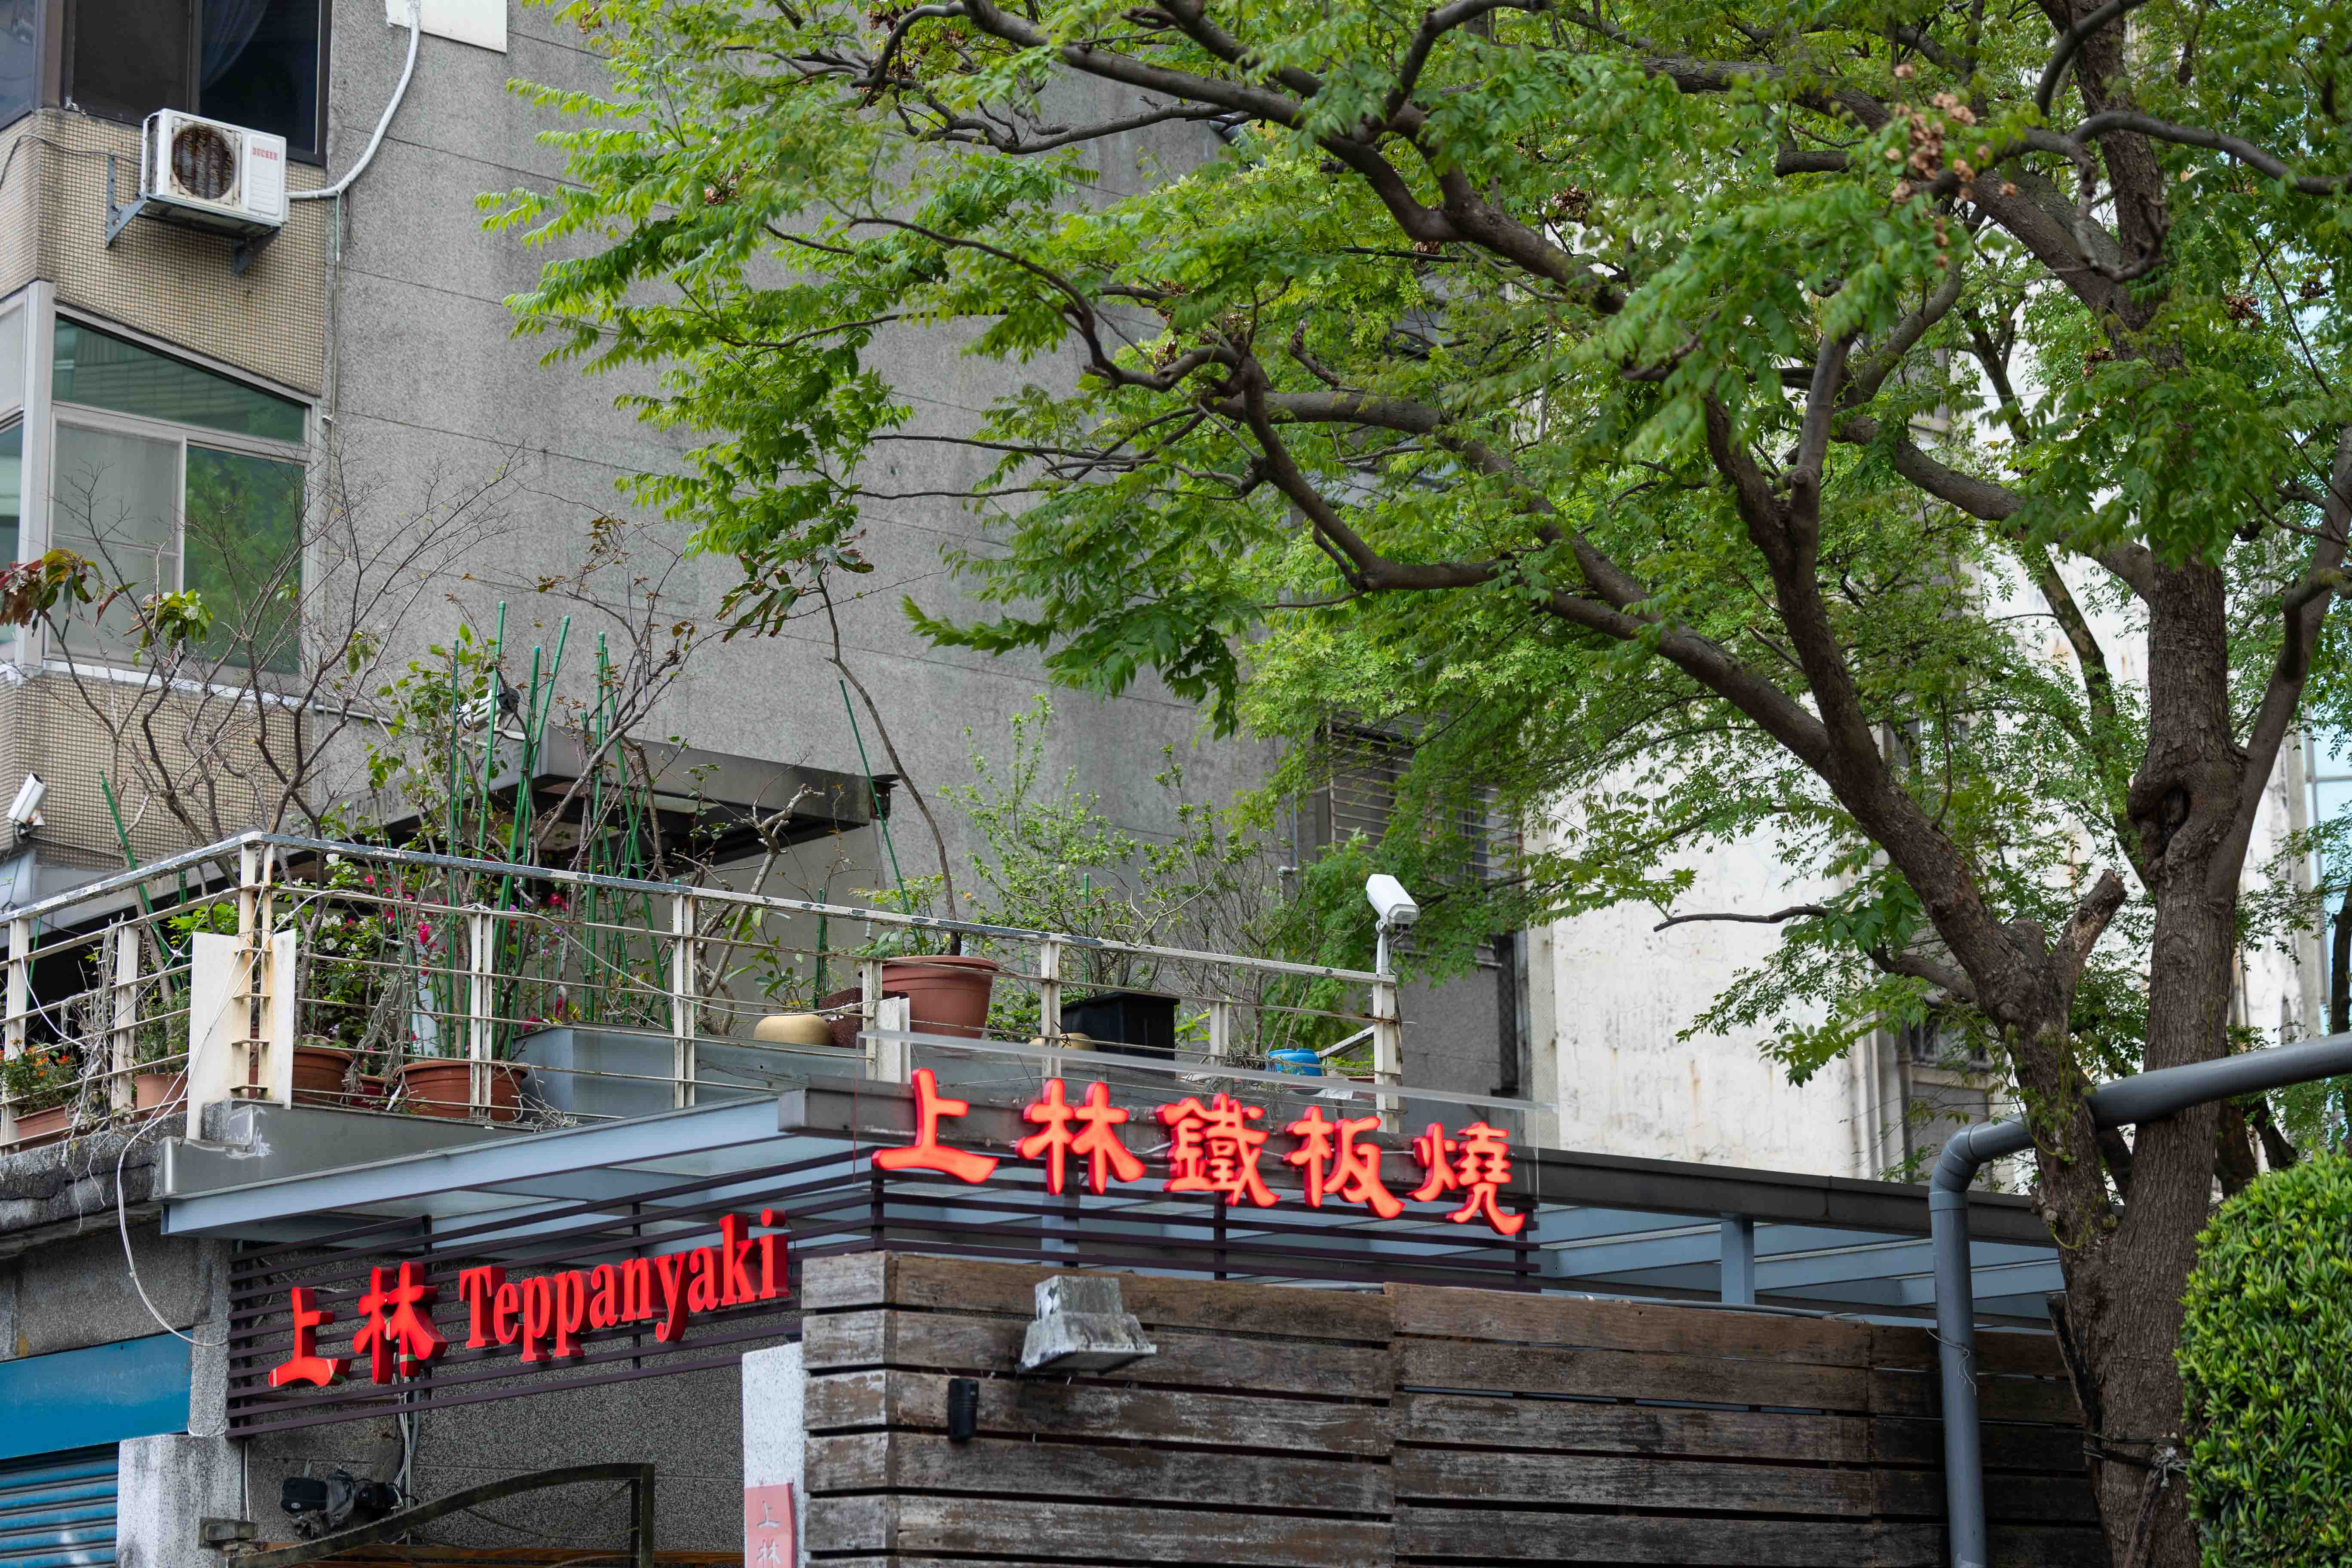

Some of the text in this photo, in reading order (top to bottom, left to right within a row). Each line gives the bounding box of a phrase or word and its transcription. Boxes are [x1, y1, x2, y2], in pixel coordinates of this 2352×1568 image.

[871, 1068, 1525, 1235] 上林鐵板燒
[268, 1208, 791, 1387] 上林 Teppanyaki
[756, 1500, 784, 1568] 上林
